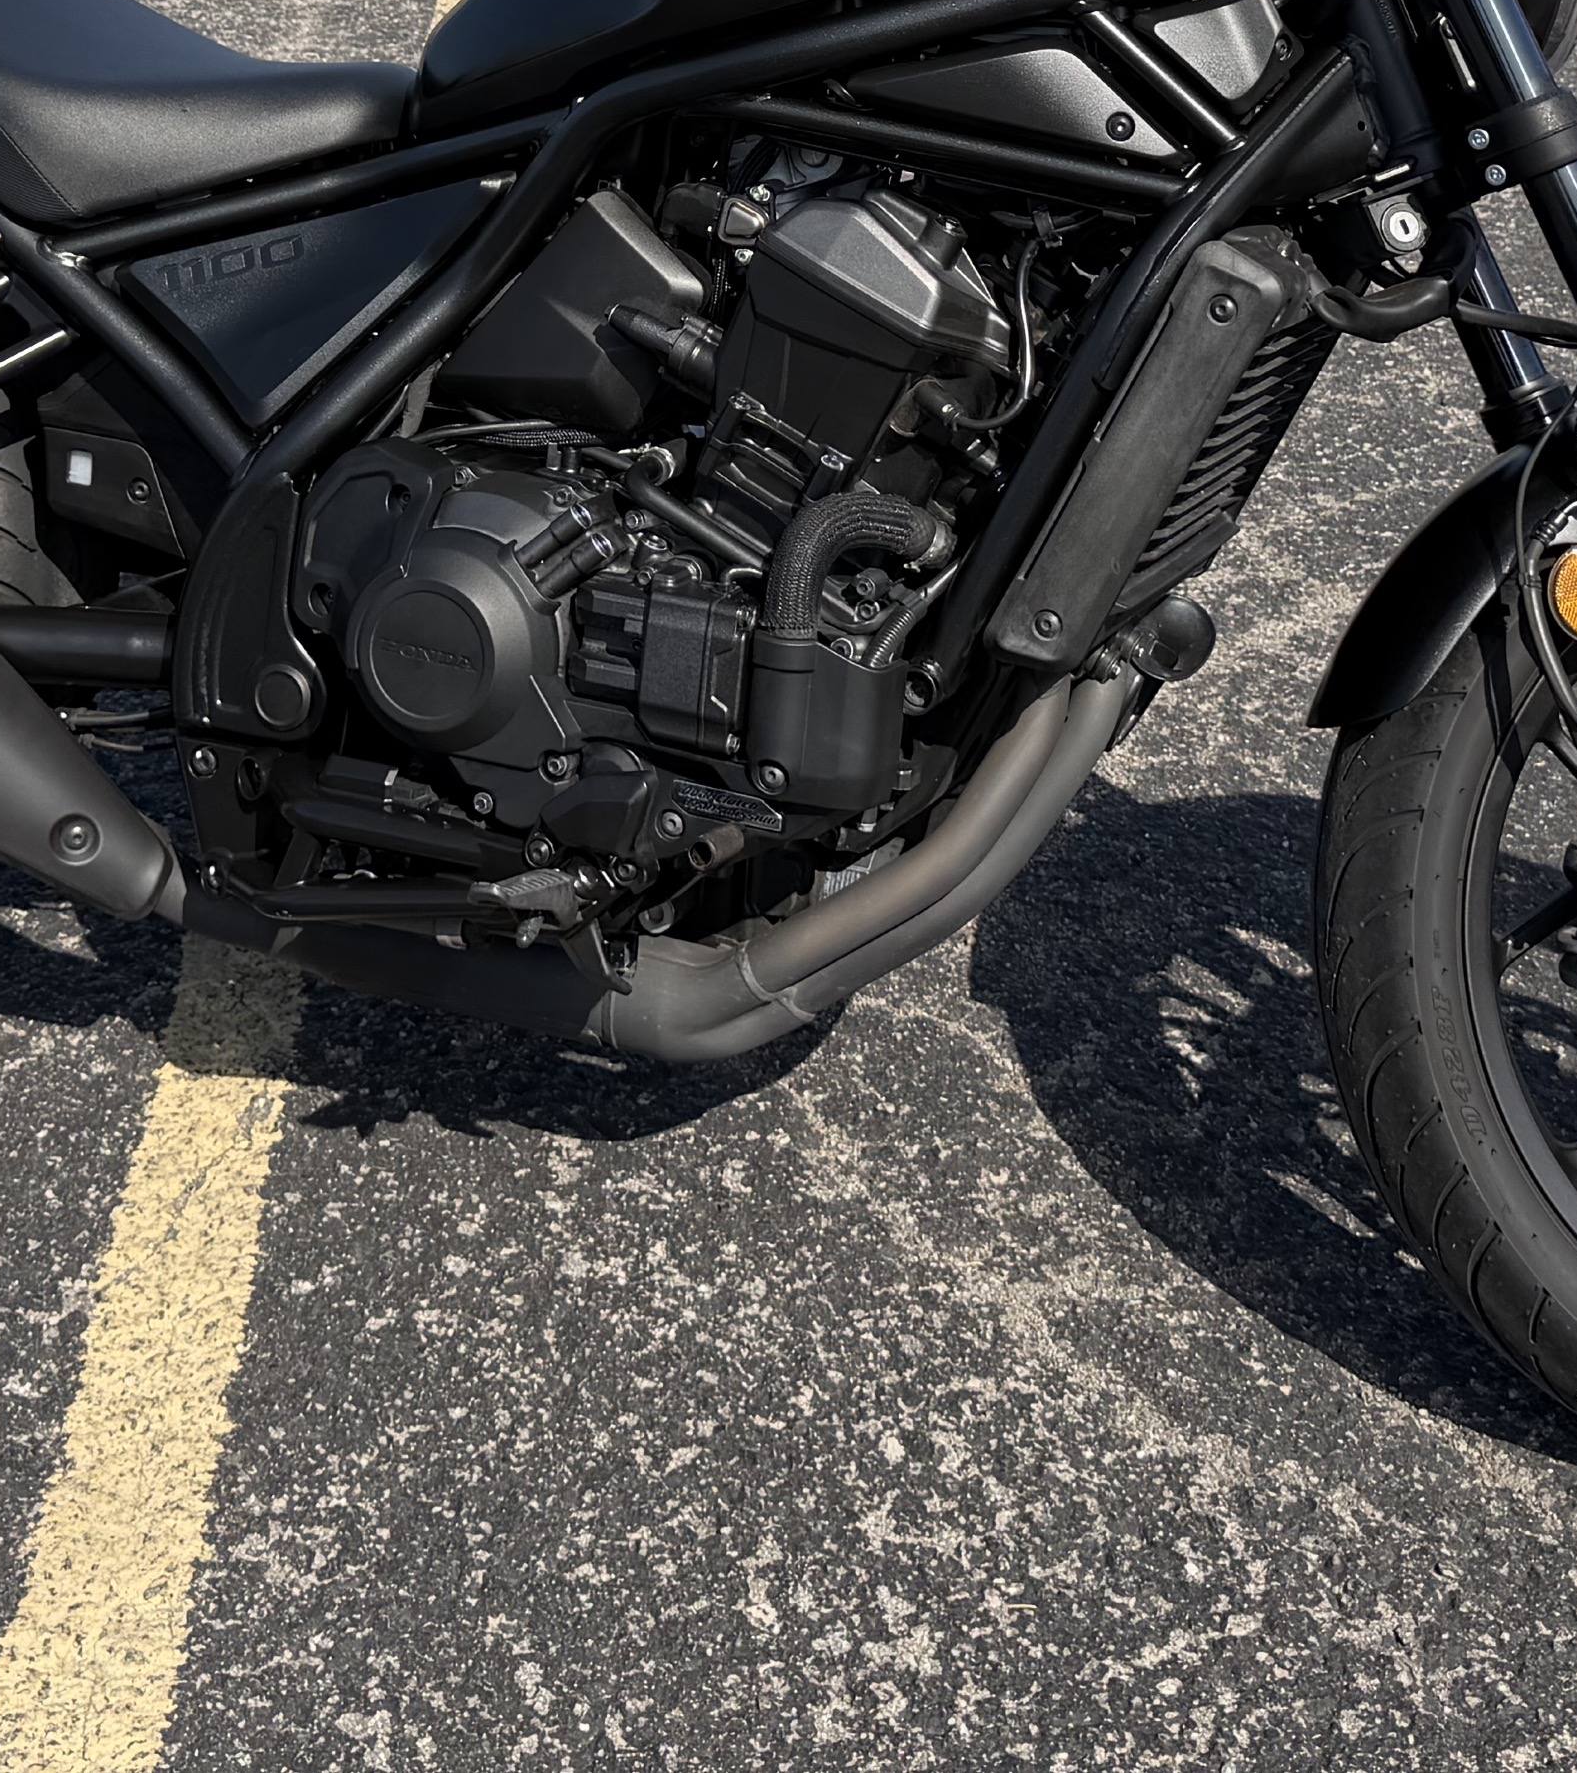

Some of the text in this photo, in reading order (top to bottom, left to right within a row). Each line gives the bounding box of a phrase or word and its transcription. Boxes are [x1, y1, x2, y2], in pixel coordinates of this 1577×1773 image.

[155, 233, 305, 291] 1100
[380, 638, 477, 670] HONDA
[1430, 984, 1488, 1138] D428F
